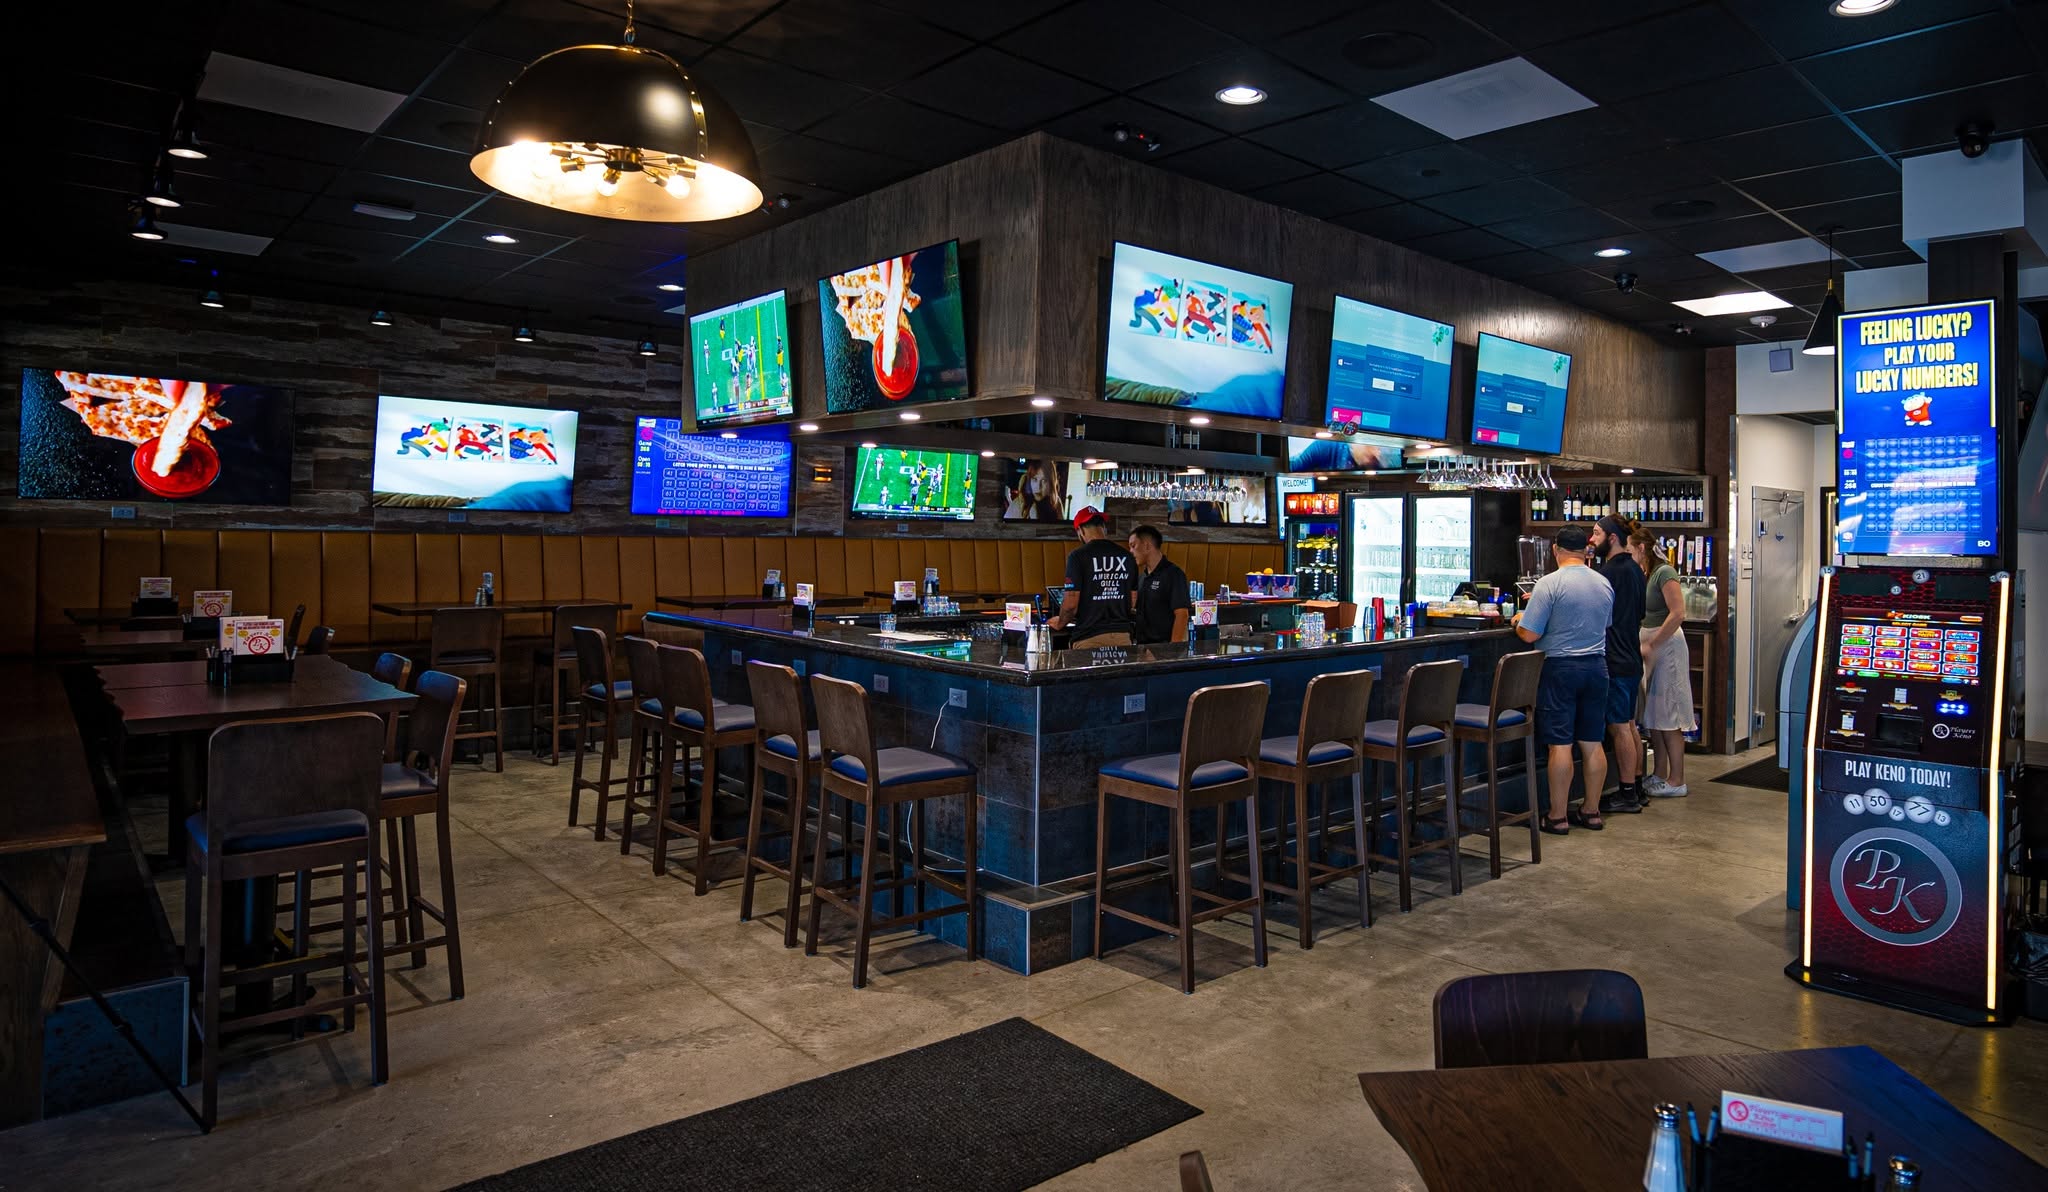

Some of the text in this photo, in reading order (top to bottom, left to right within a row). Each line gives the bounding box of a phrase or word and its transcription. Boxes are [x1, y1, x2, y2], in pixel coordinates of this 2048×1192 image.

[1861, 311, 1972, 345] FEELING LUCKY?
[1884, 342, 1955, 366] PLAY YOUR
[1855, 363, 1979, 394] LUCKY NUMBERS!
[1288, 500, 1334, 509] WINE
[1093, 556, 1126, 572] LUX
[1845, 760, 1951, 788] PLAY KENO TODAY!
[1849, 798, 1860, 808] 11
[1870, 796, 1887, 807] 50
[1909, 801, 1930, 816] 77
[1937, 814, 1946, 822] 13
[1855, 848, 1936, 924] PK
